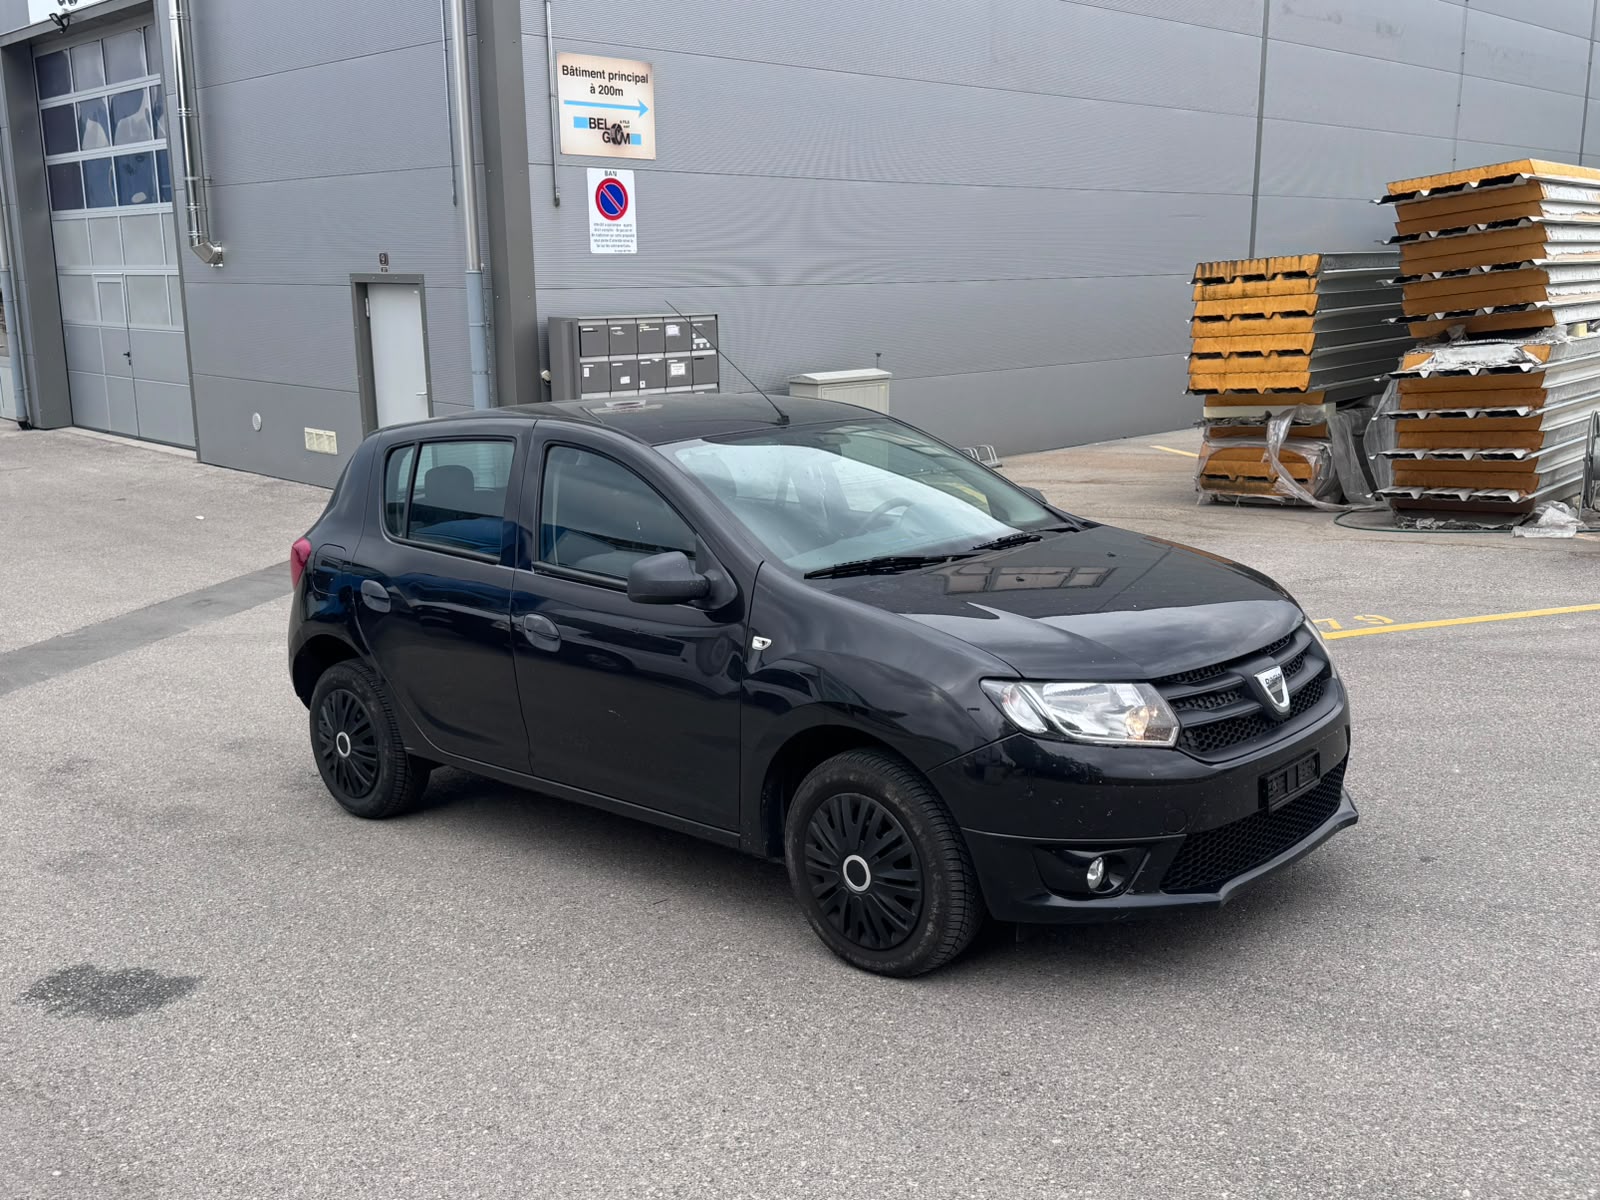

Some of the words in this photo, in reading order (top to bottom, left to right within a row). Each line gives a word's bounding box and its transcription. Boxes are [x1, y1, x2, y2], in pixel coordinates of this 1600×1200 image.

[562, 65, 605, 79] Bâtiment
[608, 71, 649, 85] principal
[590, 83, 596, 94] à
[598, 85, 624, 96] 200m
